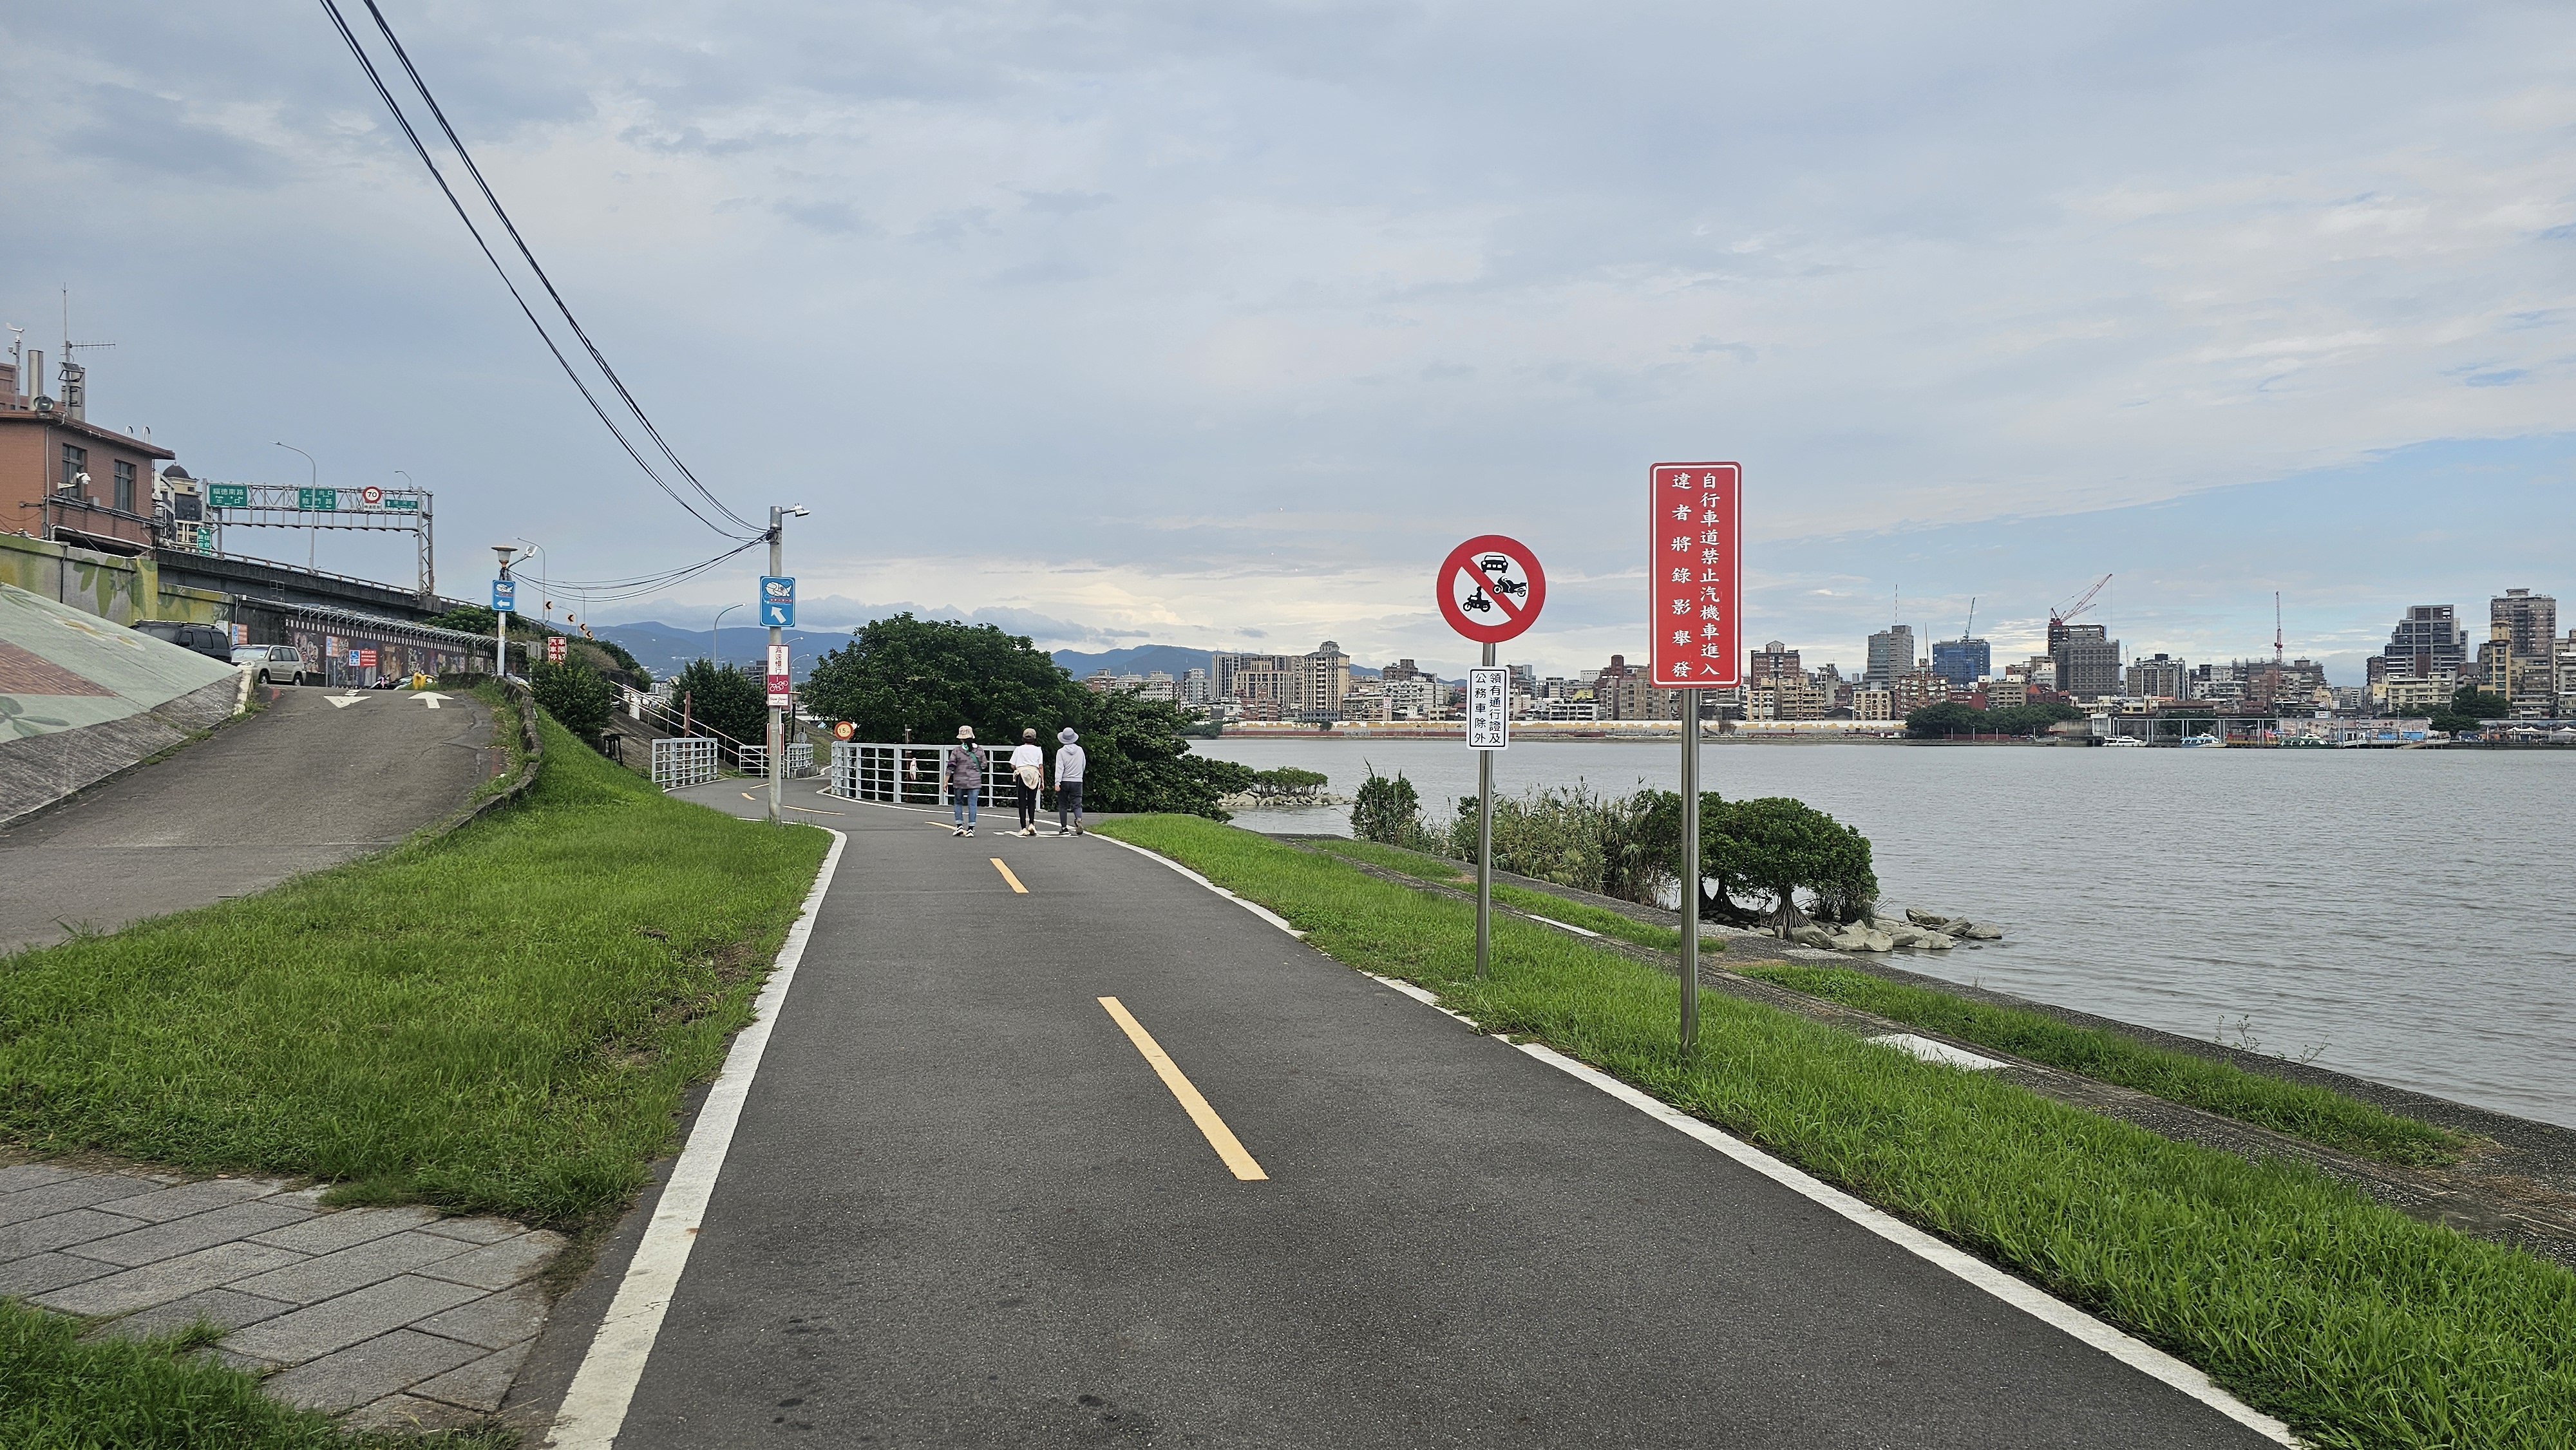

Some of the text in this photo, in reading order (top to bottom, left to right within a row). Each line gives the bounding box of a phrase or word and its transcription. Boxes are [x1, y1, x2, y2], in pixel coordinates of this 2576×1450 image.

[1671, 472, 1692, 677] 違者將錄影舉發
[1700, 472, 1721, 675] 自行車道禁止汽機車進入
[1474, 673, 1487, 744] 公務車除外
[1489, 673, 1502, 744] 領有通行證及
